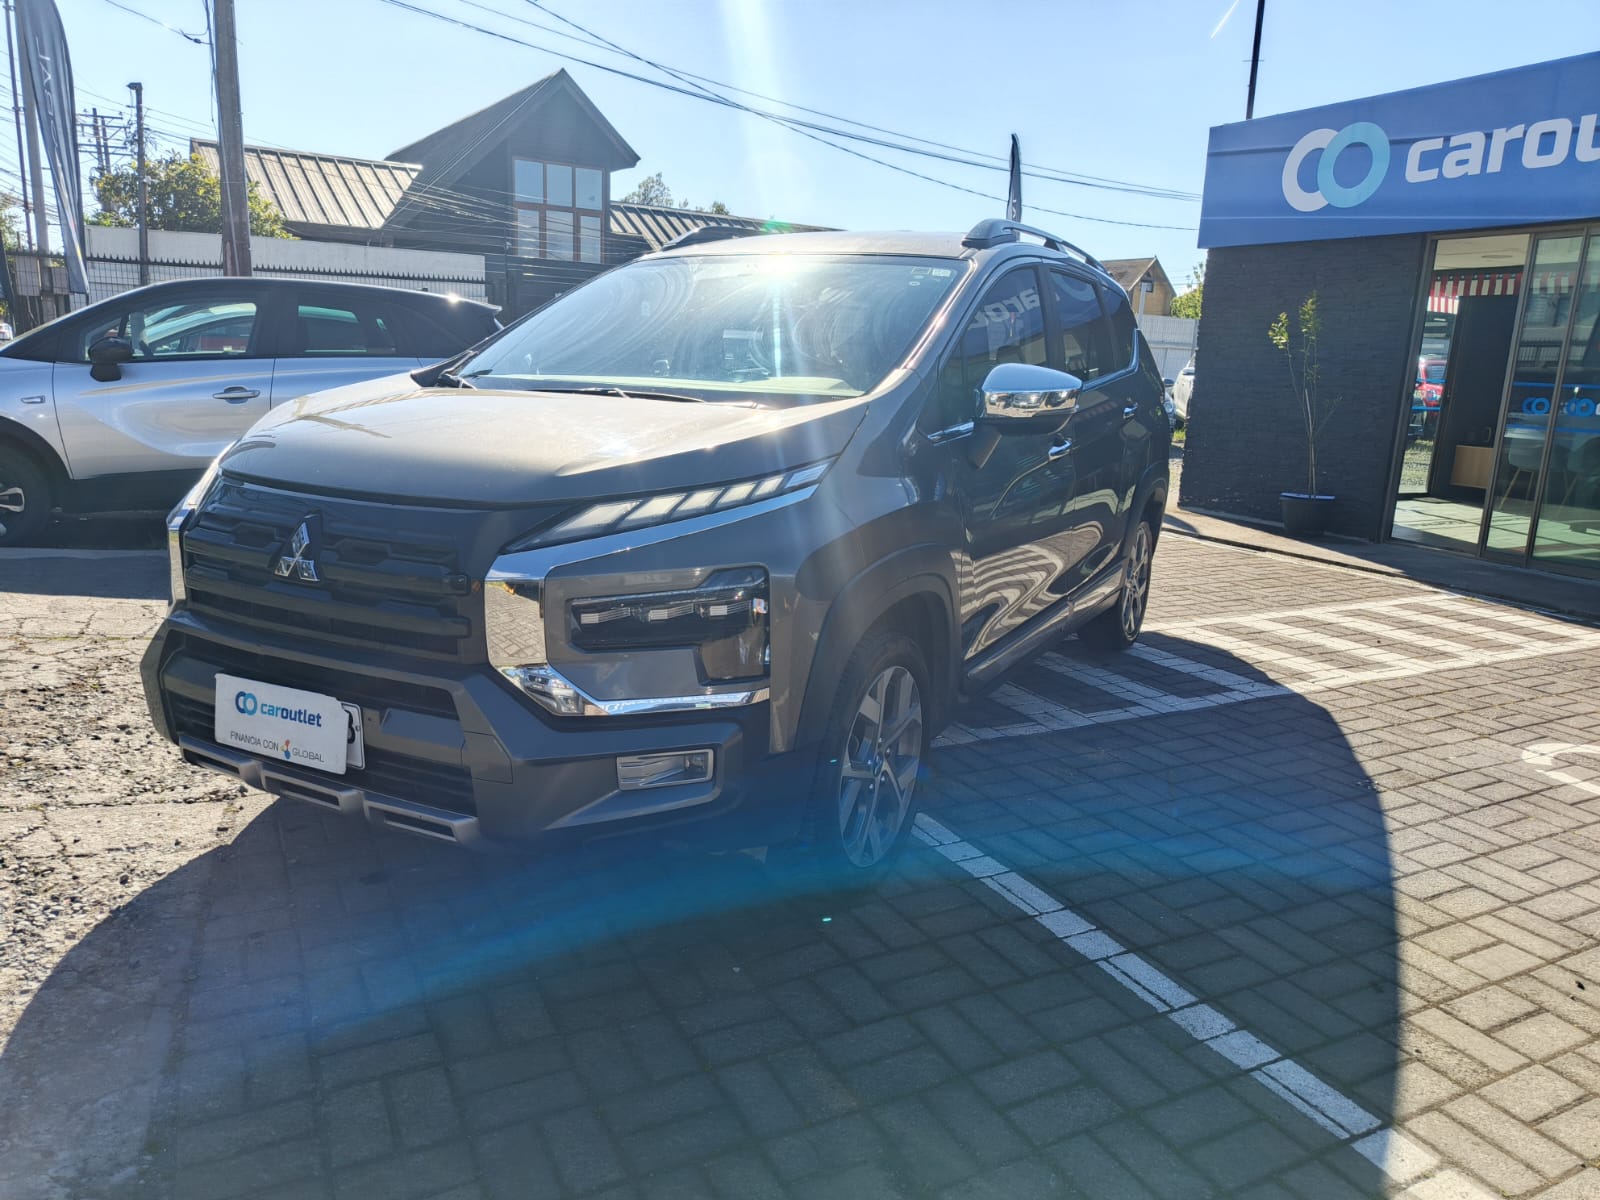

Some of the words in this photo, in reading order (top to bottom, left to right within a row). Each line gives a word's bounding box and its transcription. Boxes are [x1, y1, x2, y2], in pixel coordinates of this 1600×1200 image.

[260, 702, 321, 727] caroutlet
[230, 730, 262, 747] FINANCIA
[263, 739, 279, 751] CON
[292, 747, 325, 763] GLOBAL
